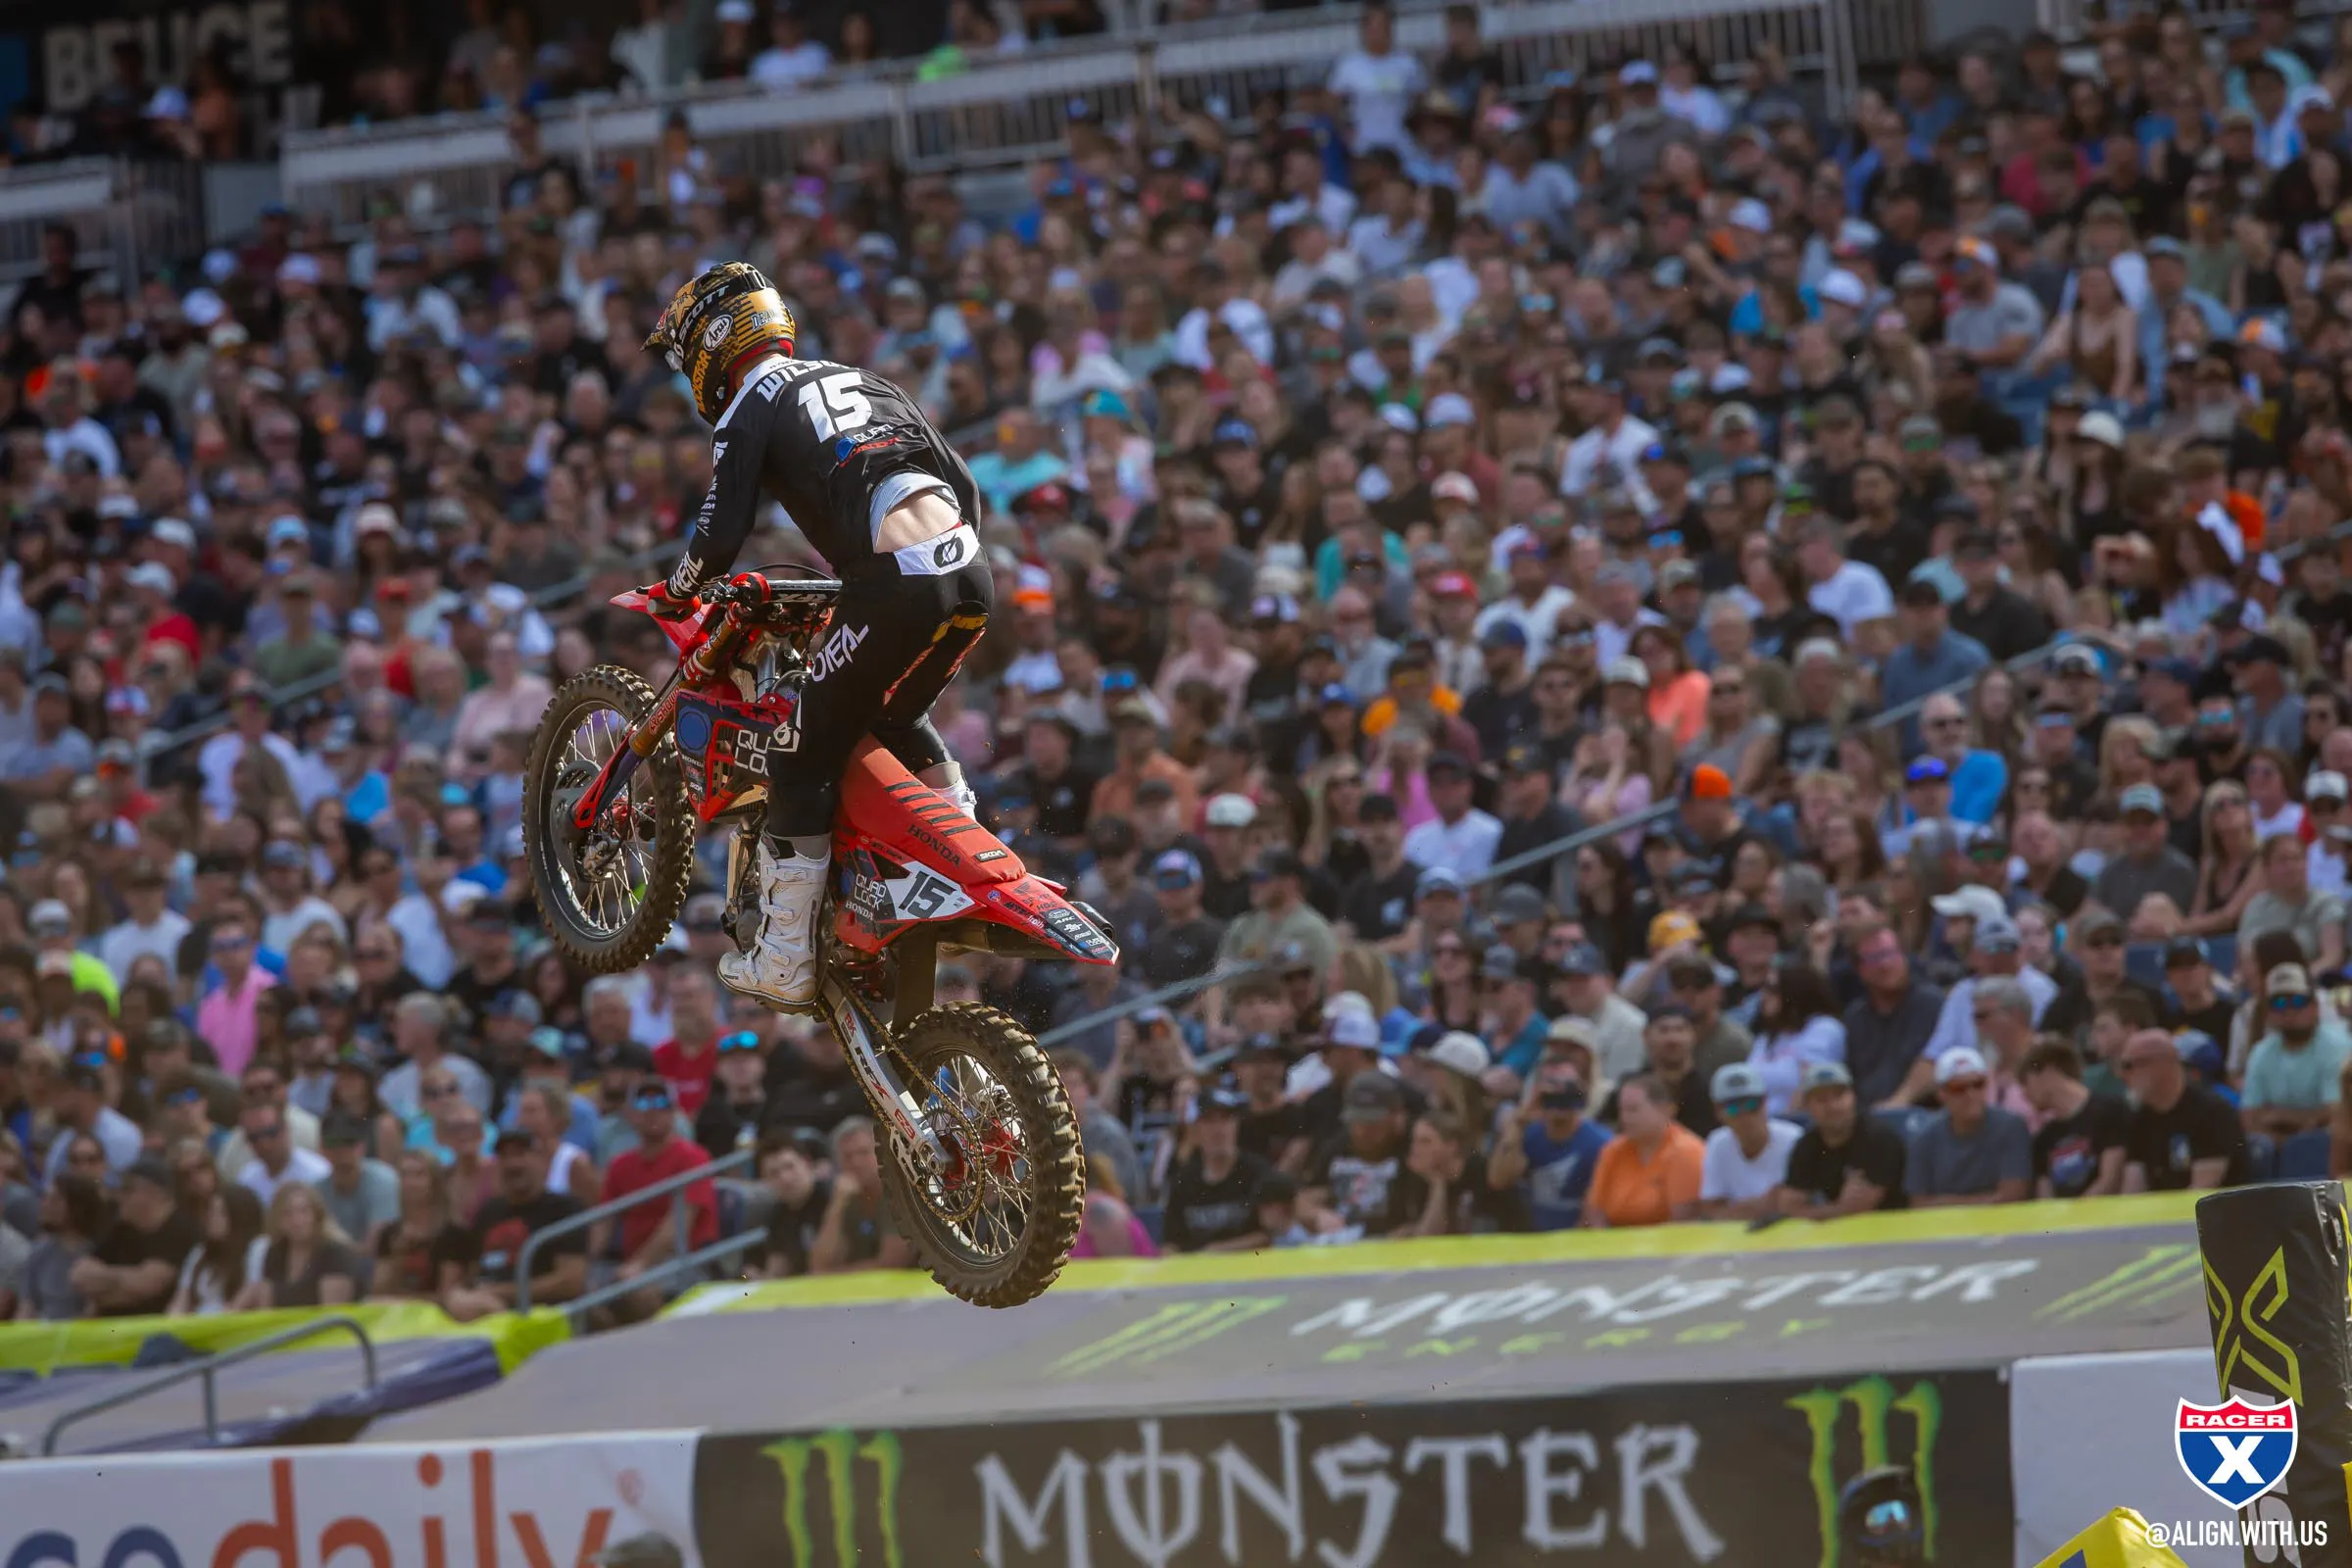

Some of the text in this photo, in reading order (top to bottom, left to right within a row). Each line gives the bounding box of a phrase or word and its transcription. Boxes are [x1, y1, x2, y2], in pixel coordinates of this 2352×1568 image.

[678, 284, 729, 345] SCOTT
[798, 371, 872, 444] 15
[907, 823, 961, 868] HONDA
[854, 885, 884, 911] LOCK
[855, 872, 888, 898] QUAD
[899, 870, 956, 919] 15
[845, 900, 874, 921] HONDA
